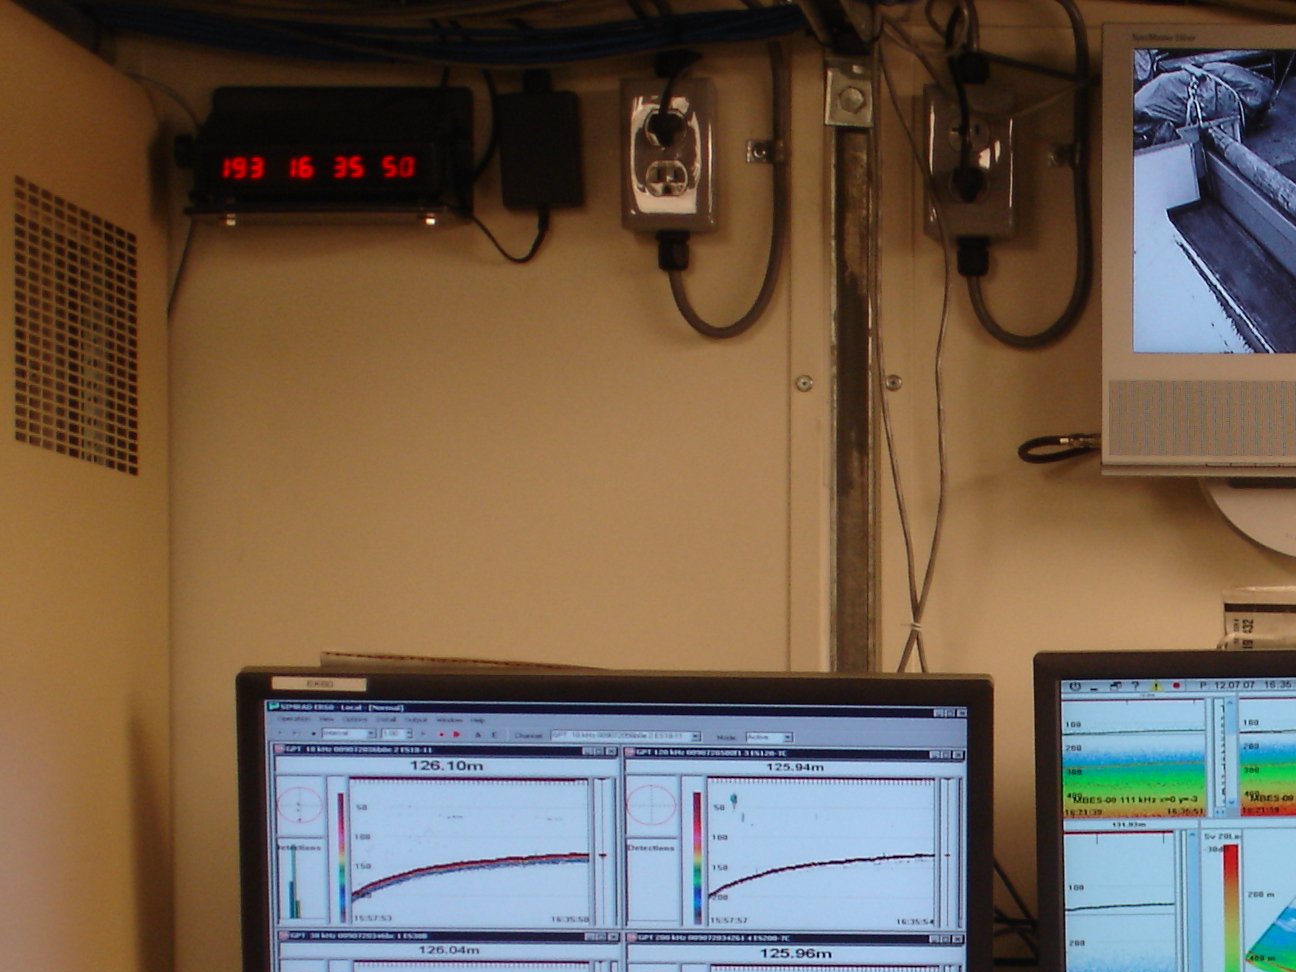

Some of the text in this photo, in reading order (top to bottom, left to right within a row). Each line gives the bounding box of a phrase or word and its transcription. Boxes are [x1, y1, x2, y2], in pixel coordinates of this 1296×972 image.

[222, 156, 416, 179] 193 16 35 50
[411, 760, 484, 773] 126.10m
[767, 762, 825, 773] 125.94m
[1138, 796, 1156, 804] kHz
[419, 945, 481, 956] 126.04m
[760, 948, 833, 960] 125.96m
